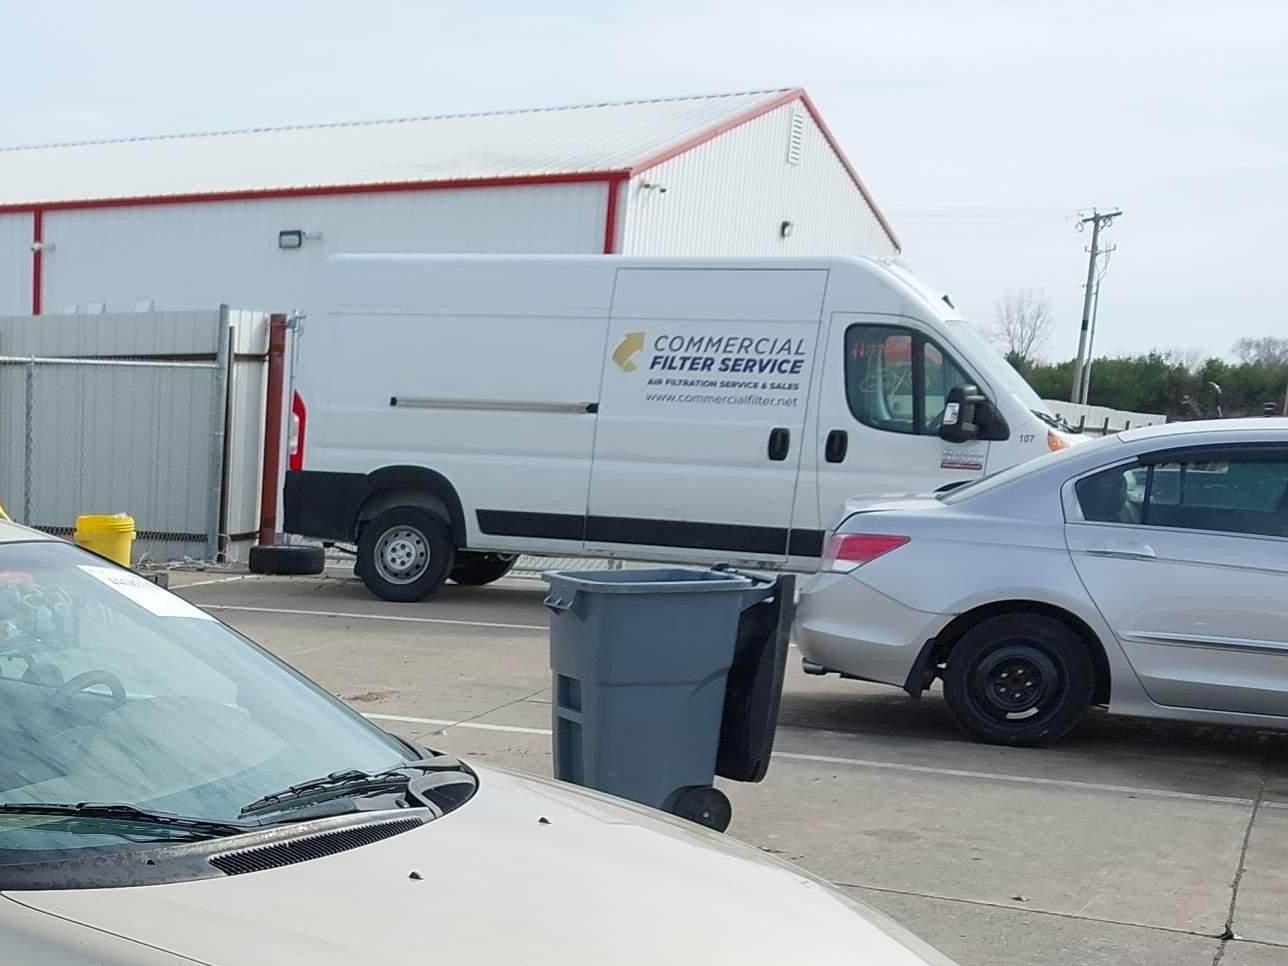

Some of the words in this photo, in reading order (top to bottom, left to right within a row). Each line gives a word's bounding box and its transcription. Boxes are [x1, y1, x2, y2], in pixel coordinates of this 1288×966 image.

[653, 335, 806, 356] COMMERCIAL
[649, 355, 713, 373] FILTER
[717, 357, 805, 375] SERVICE
[647, 378, 663, 386] AIR
[665, 378, 718, 388] FILTRATION
[719, 380, 759, 389] SERVICE
[769, 382, 800, 391] SALES
[646, 393, 798, 407] www.commercialfilter.net
[1018, 434, 1035, 443] 107
